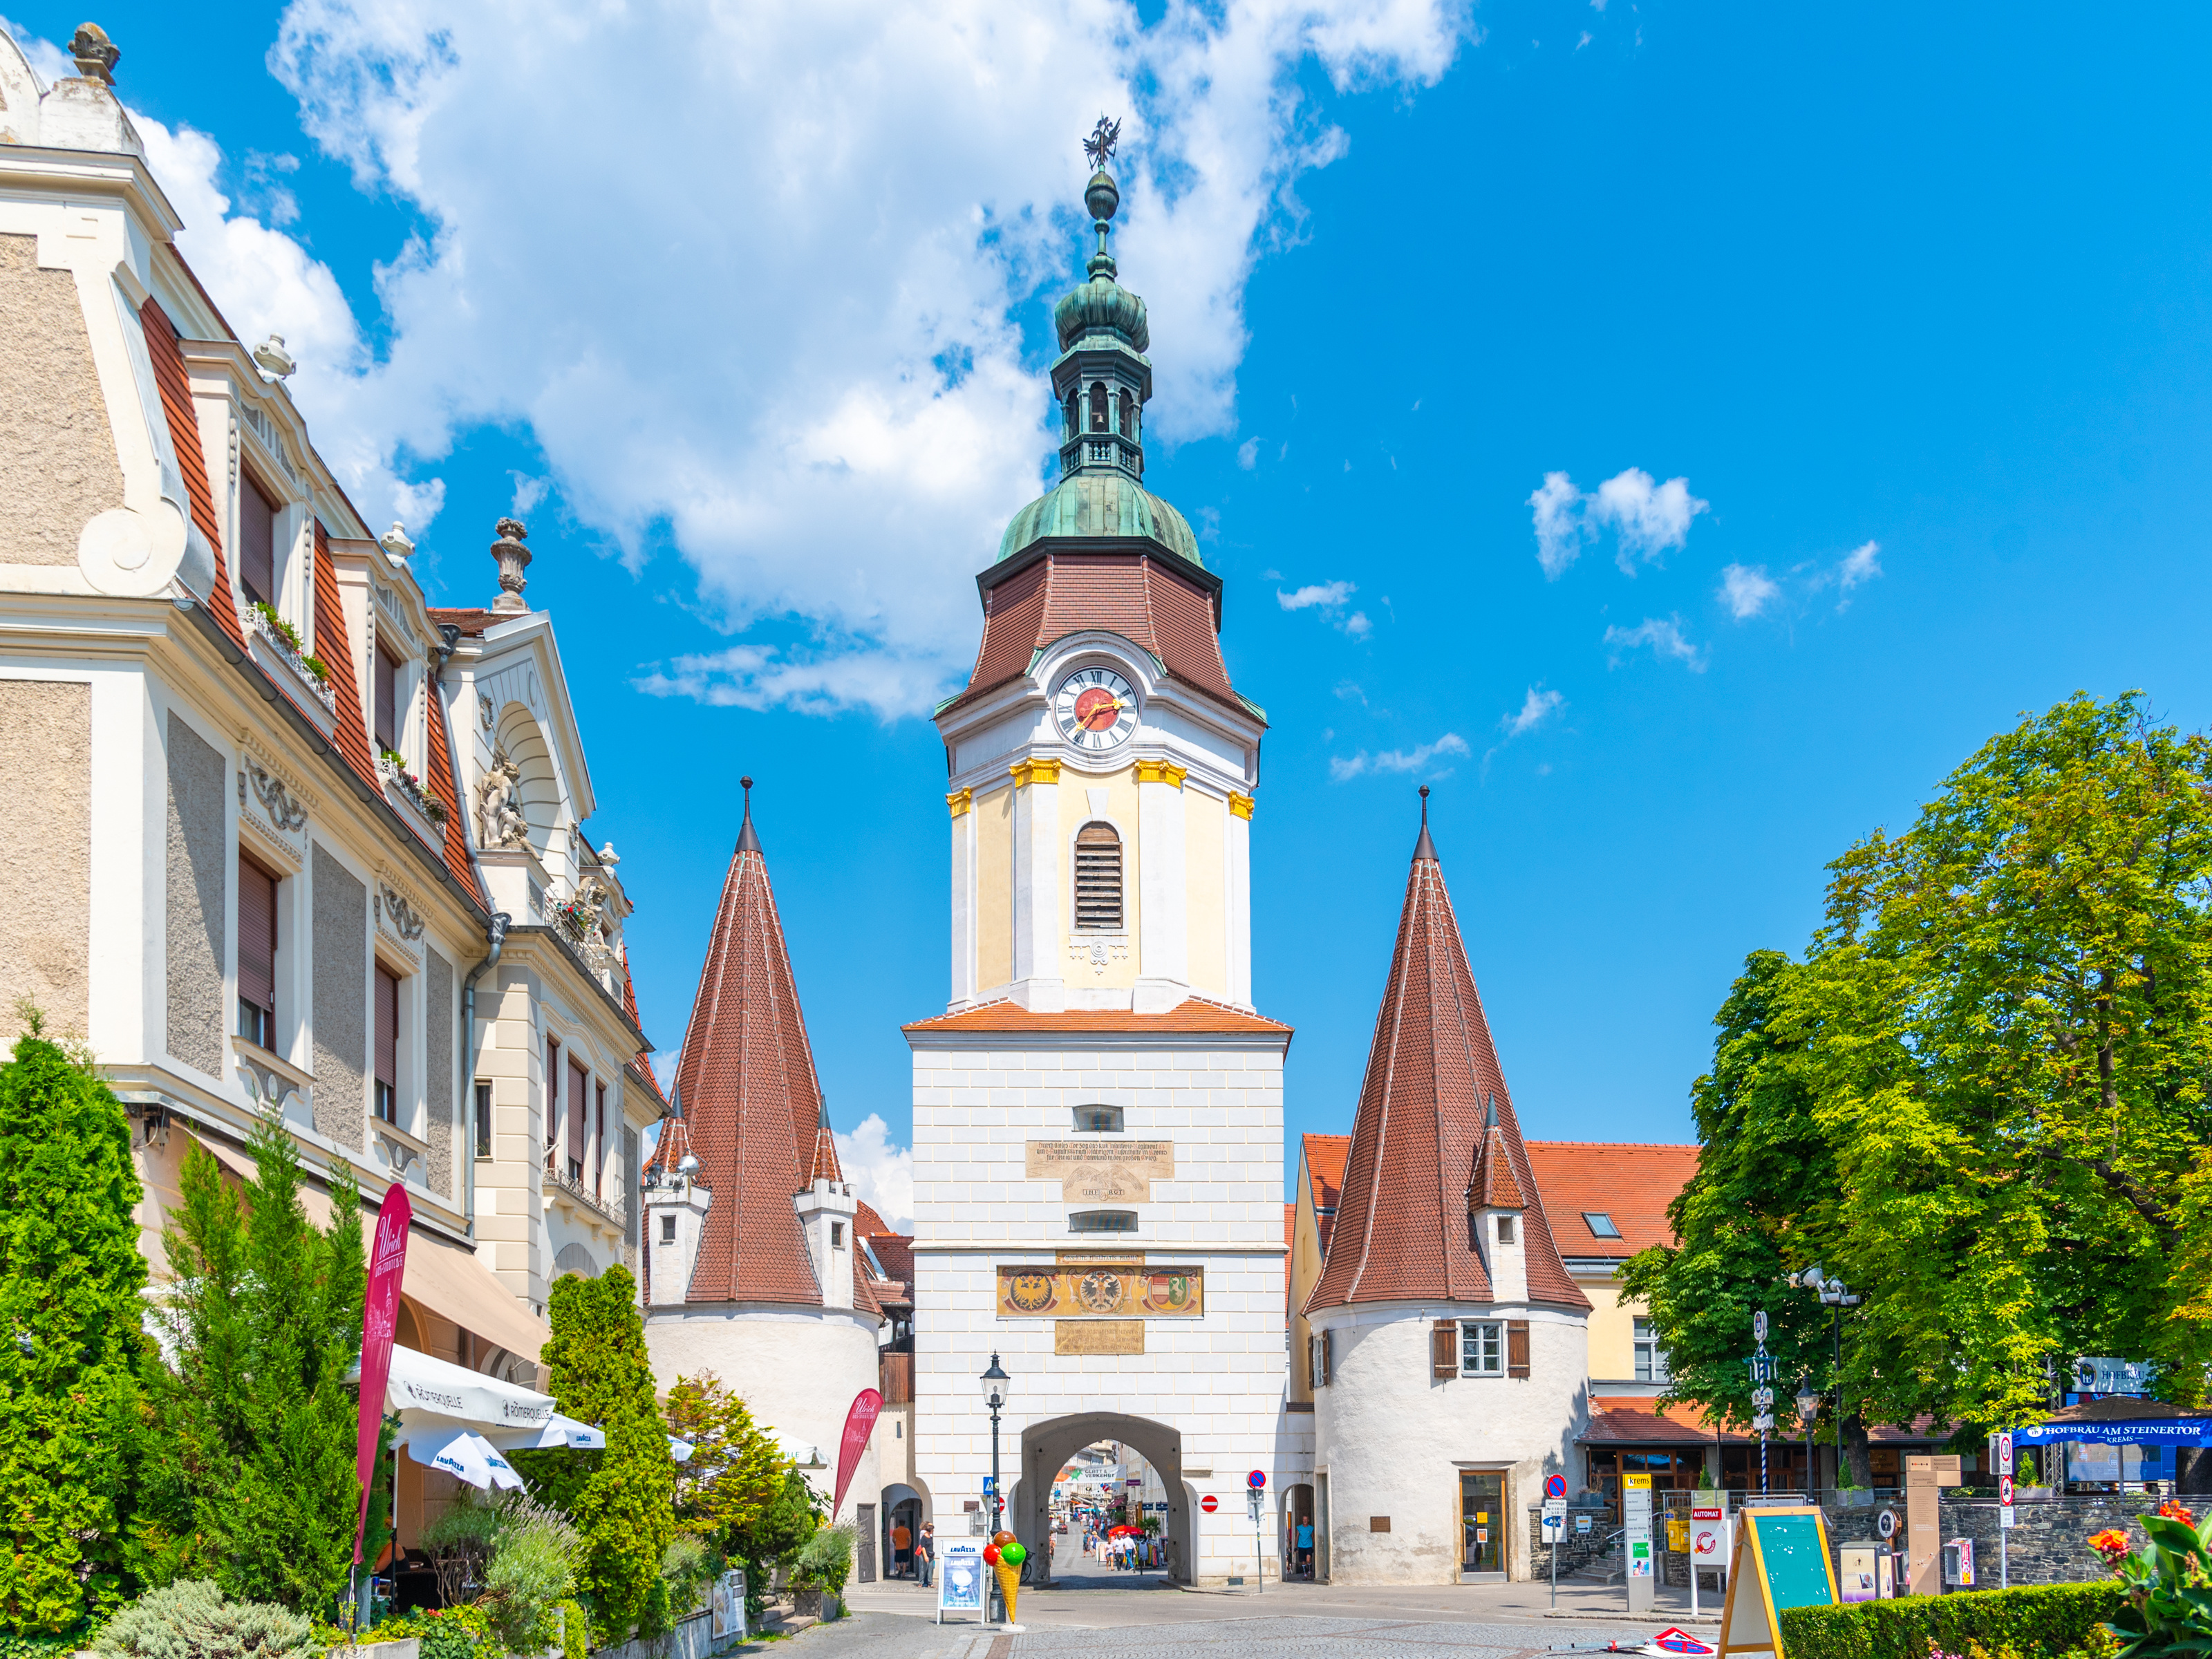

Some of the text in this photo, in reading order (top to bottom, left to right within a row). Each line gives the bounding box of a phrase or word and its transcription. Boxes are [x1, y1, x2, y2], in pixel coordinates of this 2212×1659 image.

[1073, 674, 1087, 690] XI
[1090, 671, 1103, 685] XII
[1062, 687, 1077, 699] X
[1058, 704, 1072, 714] IX
[1093, 733, 1103, 748] VI
[379, 1213, 402, 1260] Ulrich
[856, 1397, 876, 1413] Ulrich
[2045, 1425, 2099, 1434] HOFBRÄU
[2102, 1426, 2121, 1436] AM
[2124, 1426, 2201, 1436] STEINERTOR
[2003, 1443, 2009, 1455] 30
[436, 1455, 465, 1472] LAVAZZA
[2002, 1463, 2011, 1472] Zone
[1629, 1476, 1649, 1485] krems
[1702, 1542, 1715, 1554] AUTOMAT
